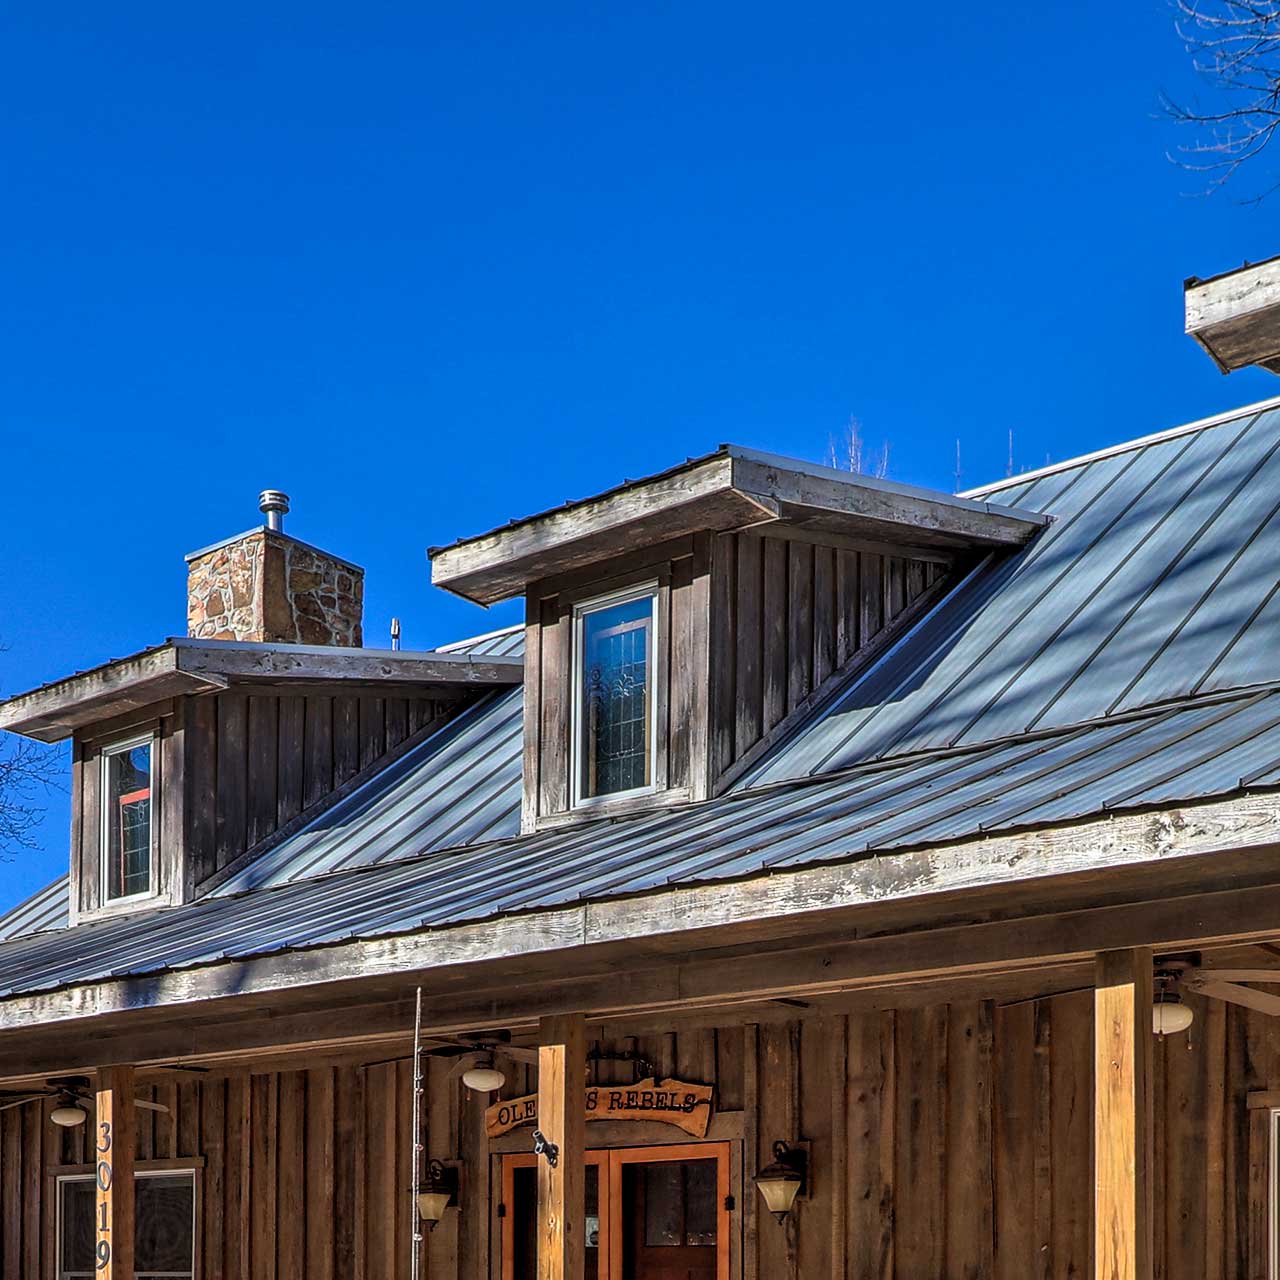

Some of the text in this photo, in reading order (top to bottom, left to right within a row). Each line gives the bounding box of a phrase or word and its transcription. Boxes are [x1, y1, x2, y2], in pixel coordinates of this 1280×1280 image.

[499, 1100, 535, 1125] OLE
[608, 1091, 696, 1113] REBELS
[96, 1122, 112, 1270] 3019
